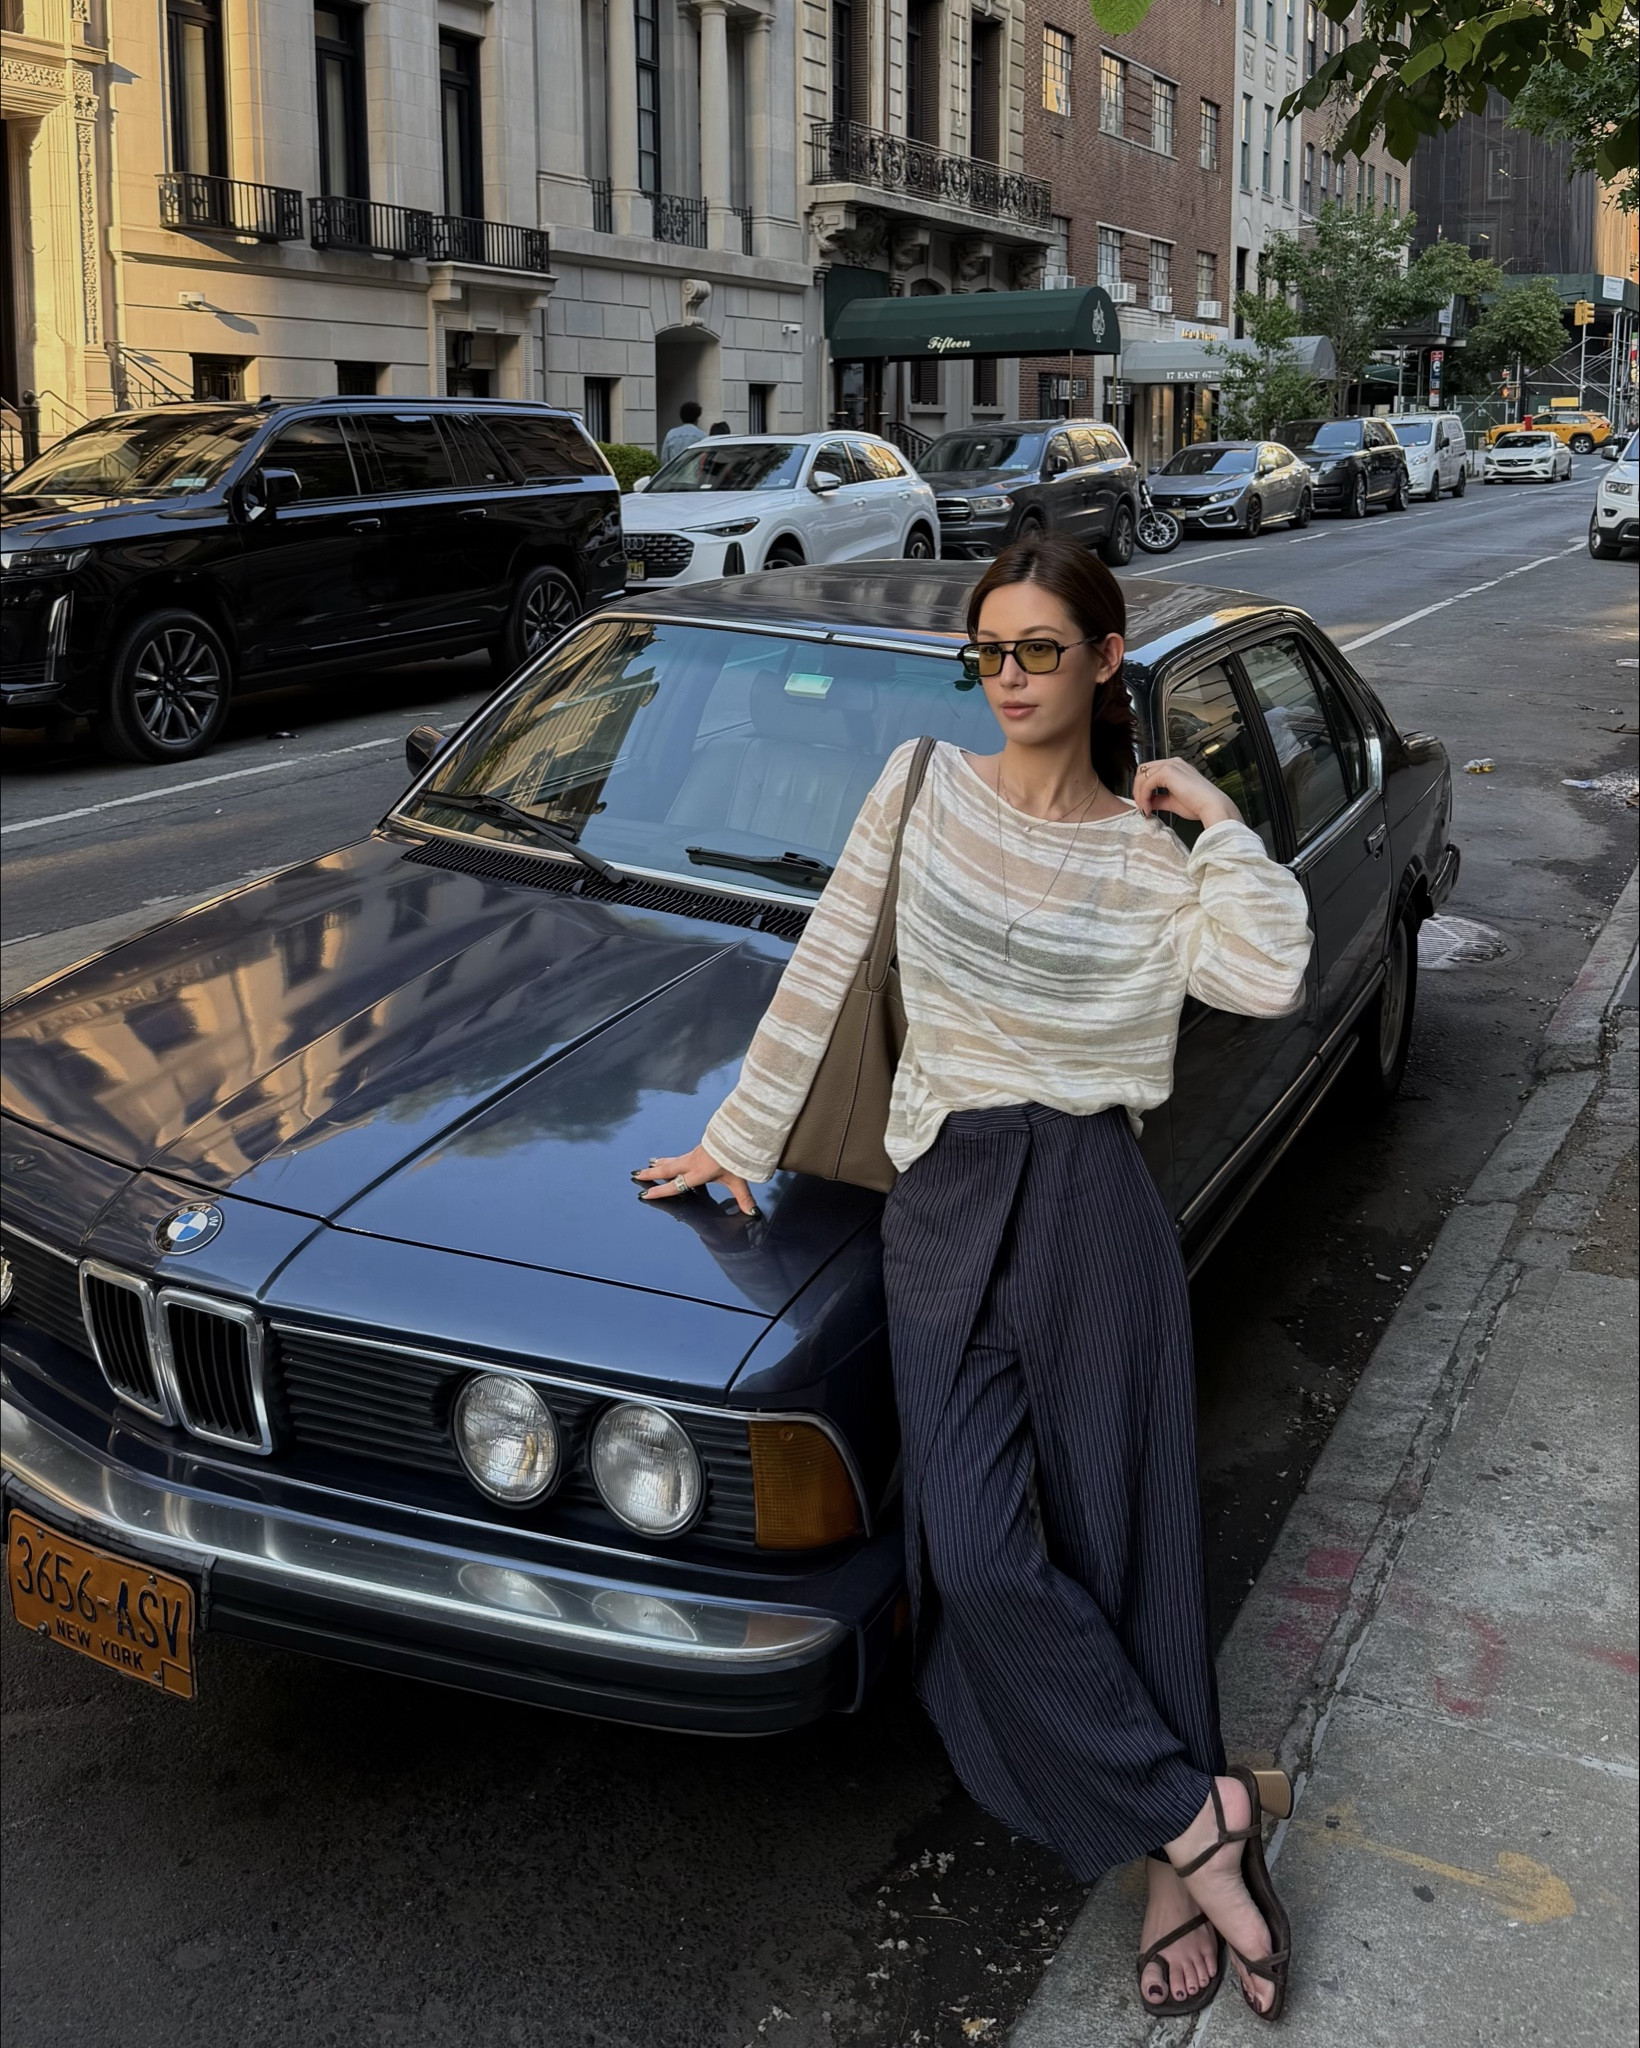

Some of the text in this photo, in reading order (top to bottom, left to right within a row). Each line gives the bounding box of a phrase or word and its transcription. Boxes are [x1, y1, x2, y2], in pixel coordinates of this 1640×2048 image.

[927, 336, 971, 354] Fifteen
[1166, 371, 1175, 380] 17
[1177, 371, 1201, 380] EAST
[16, 1535, 182, 1657] 3656-ASV
[56, 1617, 143, 1670] NEW YORK
